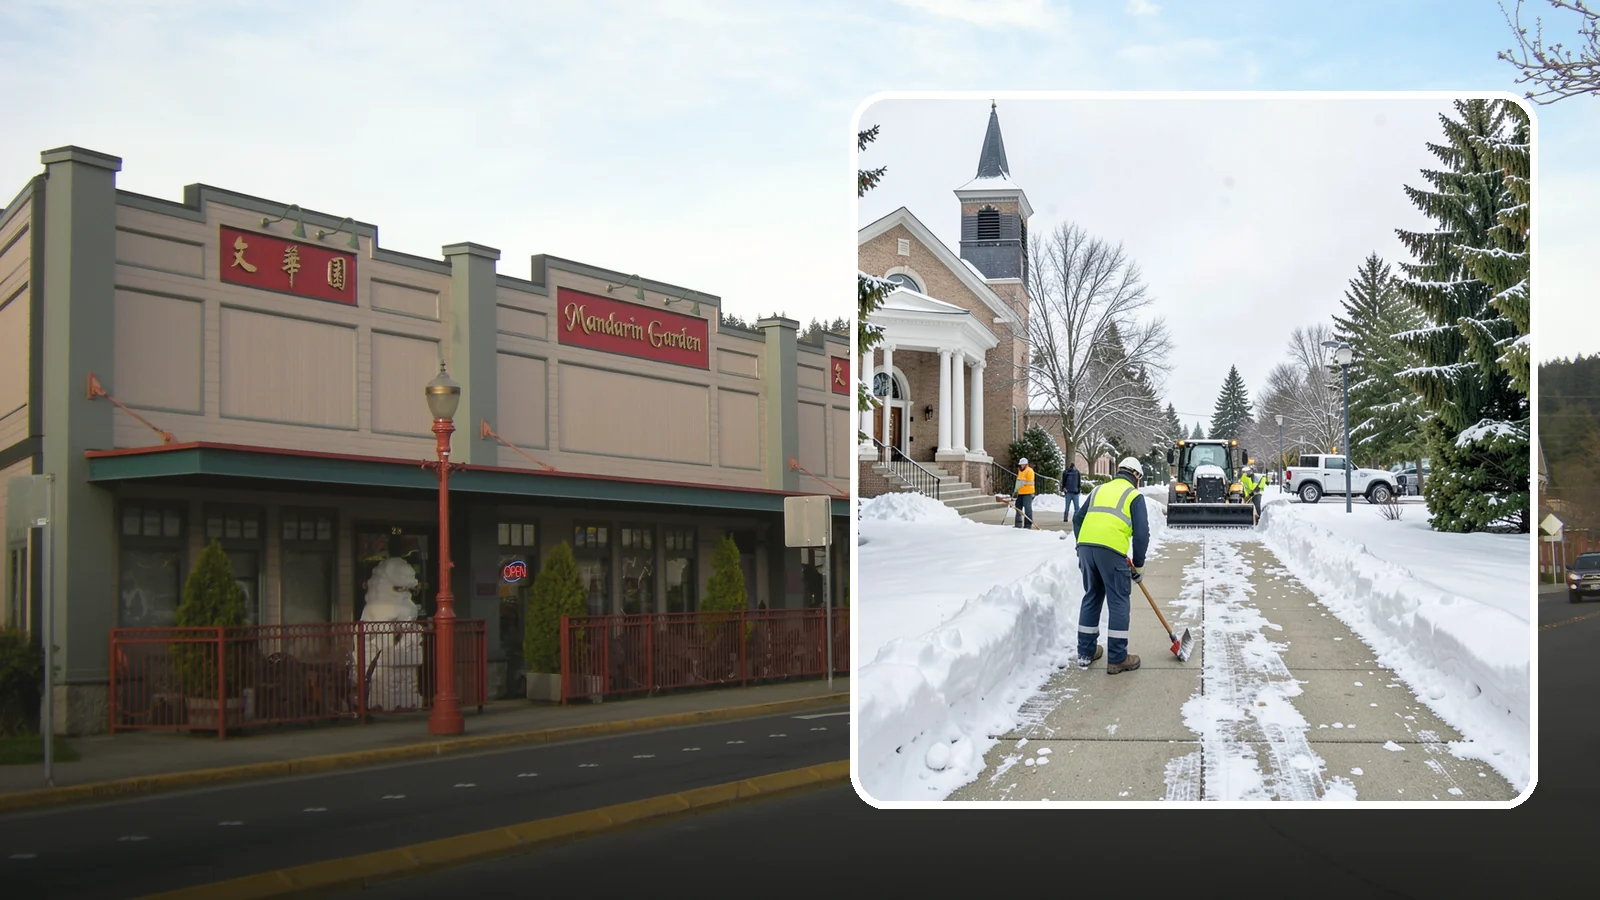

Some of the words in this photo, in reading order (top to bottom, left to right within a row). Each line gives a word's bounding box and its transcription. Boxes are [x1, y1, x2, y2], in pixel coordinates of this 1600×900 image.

[564, 302, 643, 341] Mandarin
[648, 320, 701, 352] Garden
[503, 565, 527, 579] OPEN
